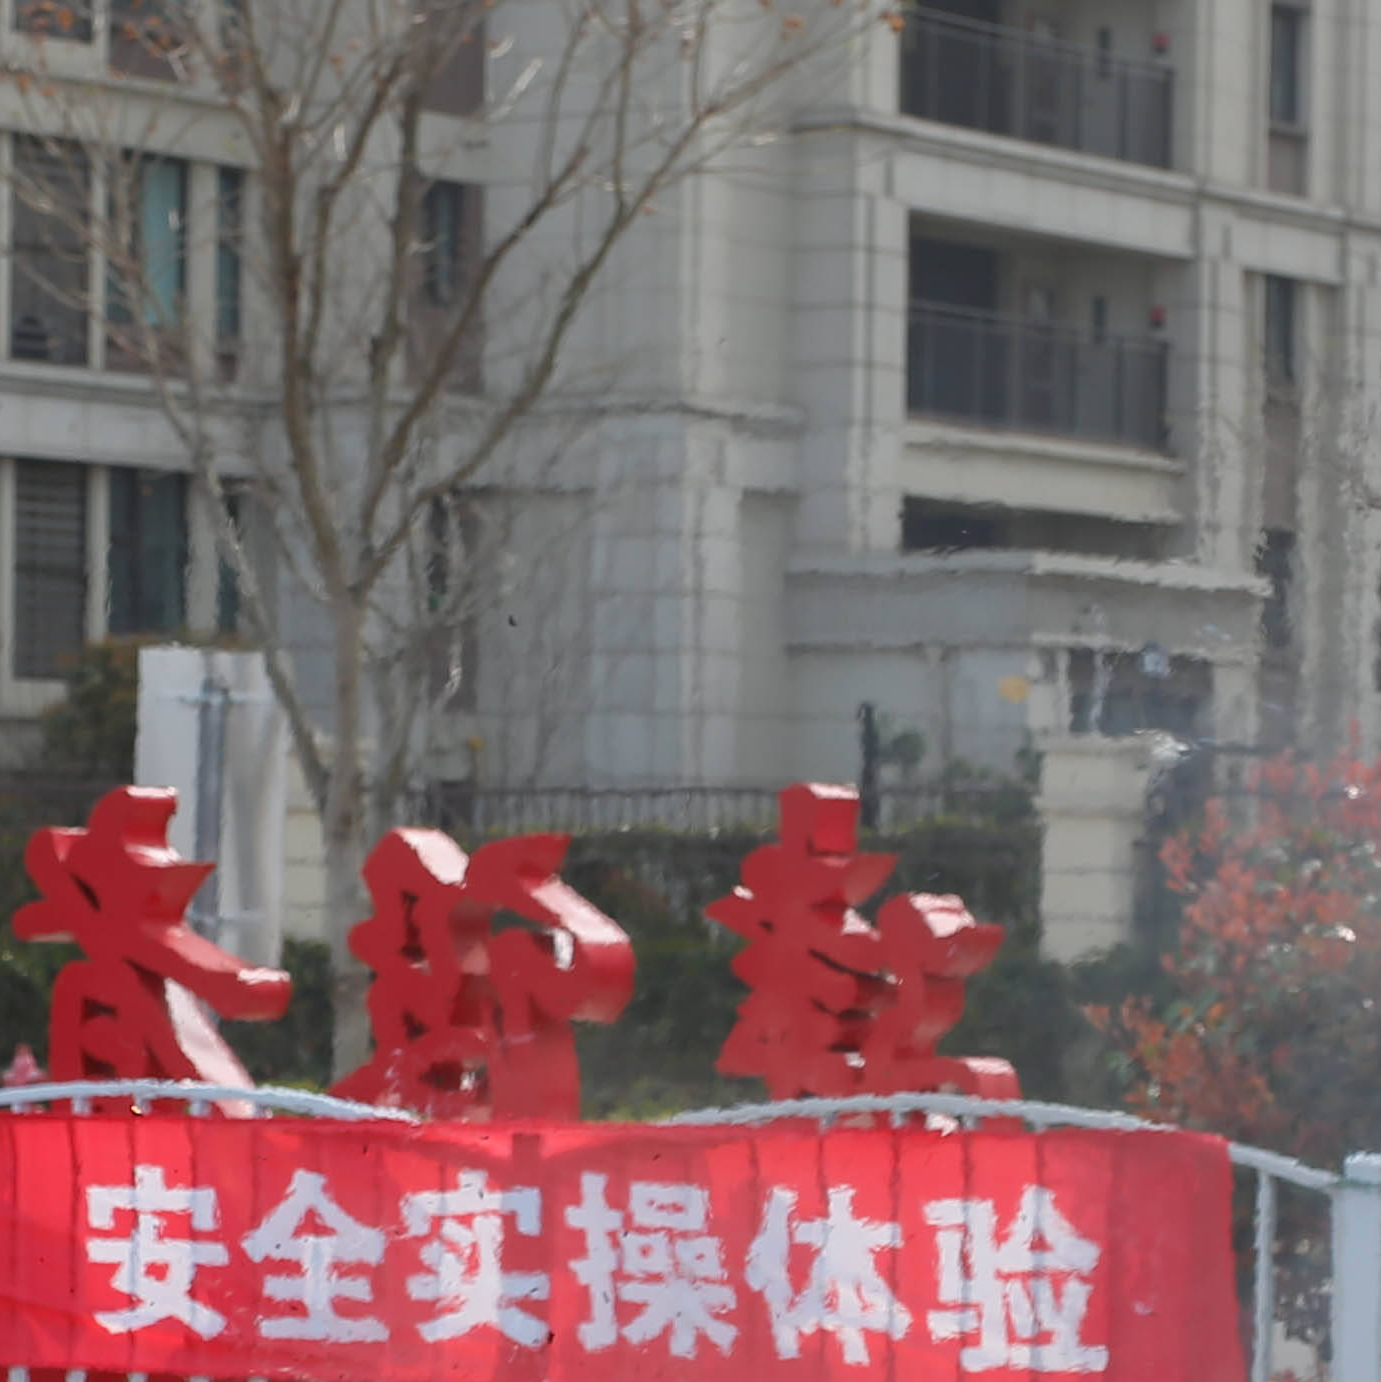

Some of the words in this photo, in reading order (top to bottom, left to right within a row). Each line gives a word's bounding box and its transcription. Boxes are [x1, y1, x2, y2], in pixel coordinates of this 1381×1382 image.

[86, 1165, 1109, 1373] 安全实操体验
